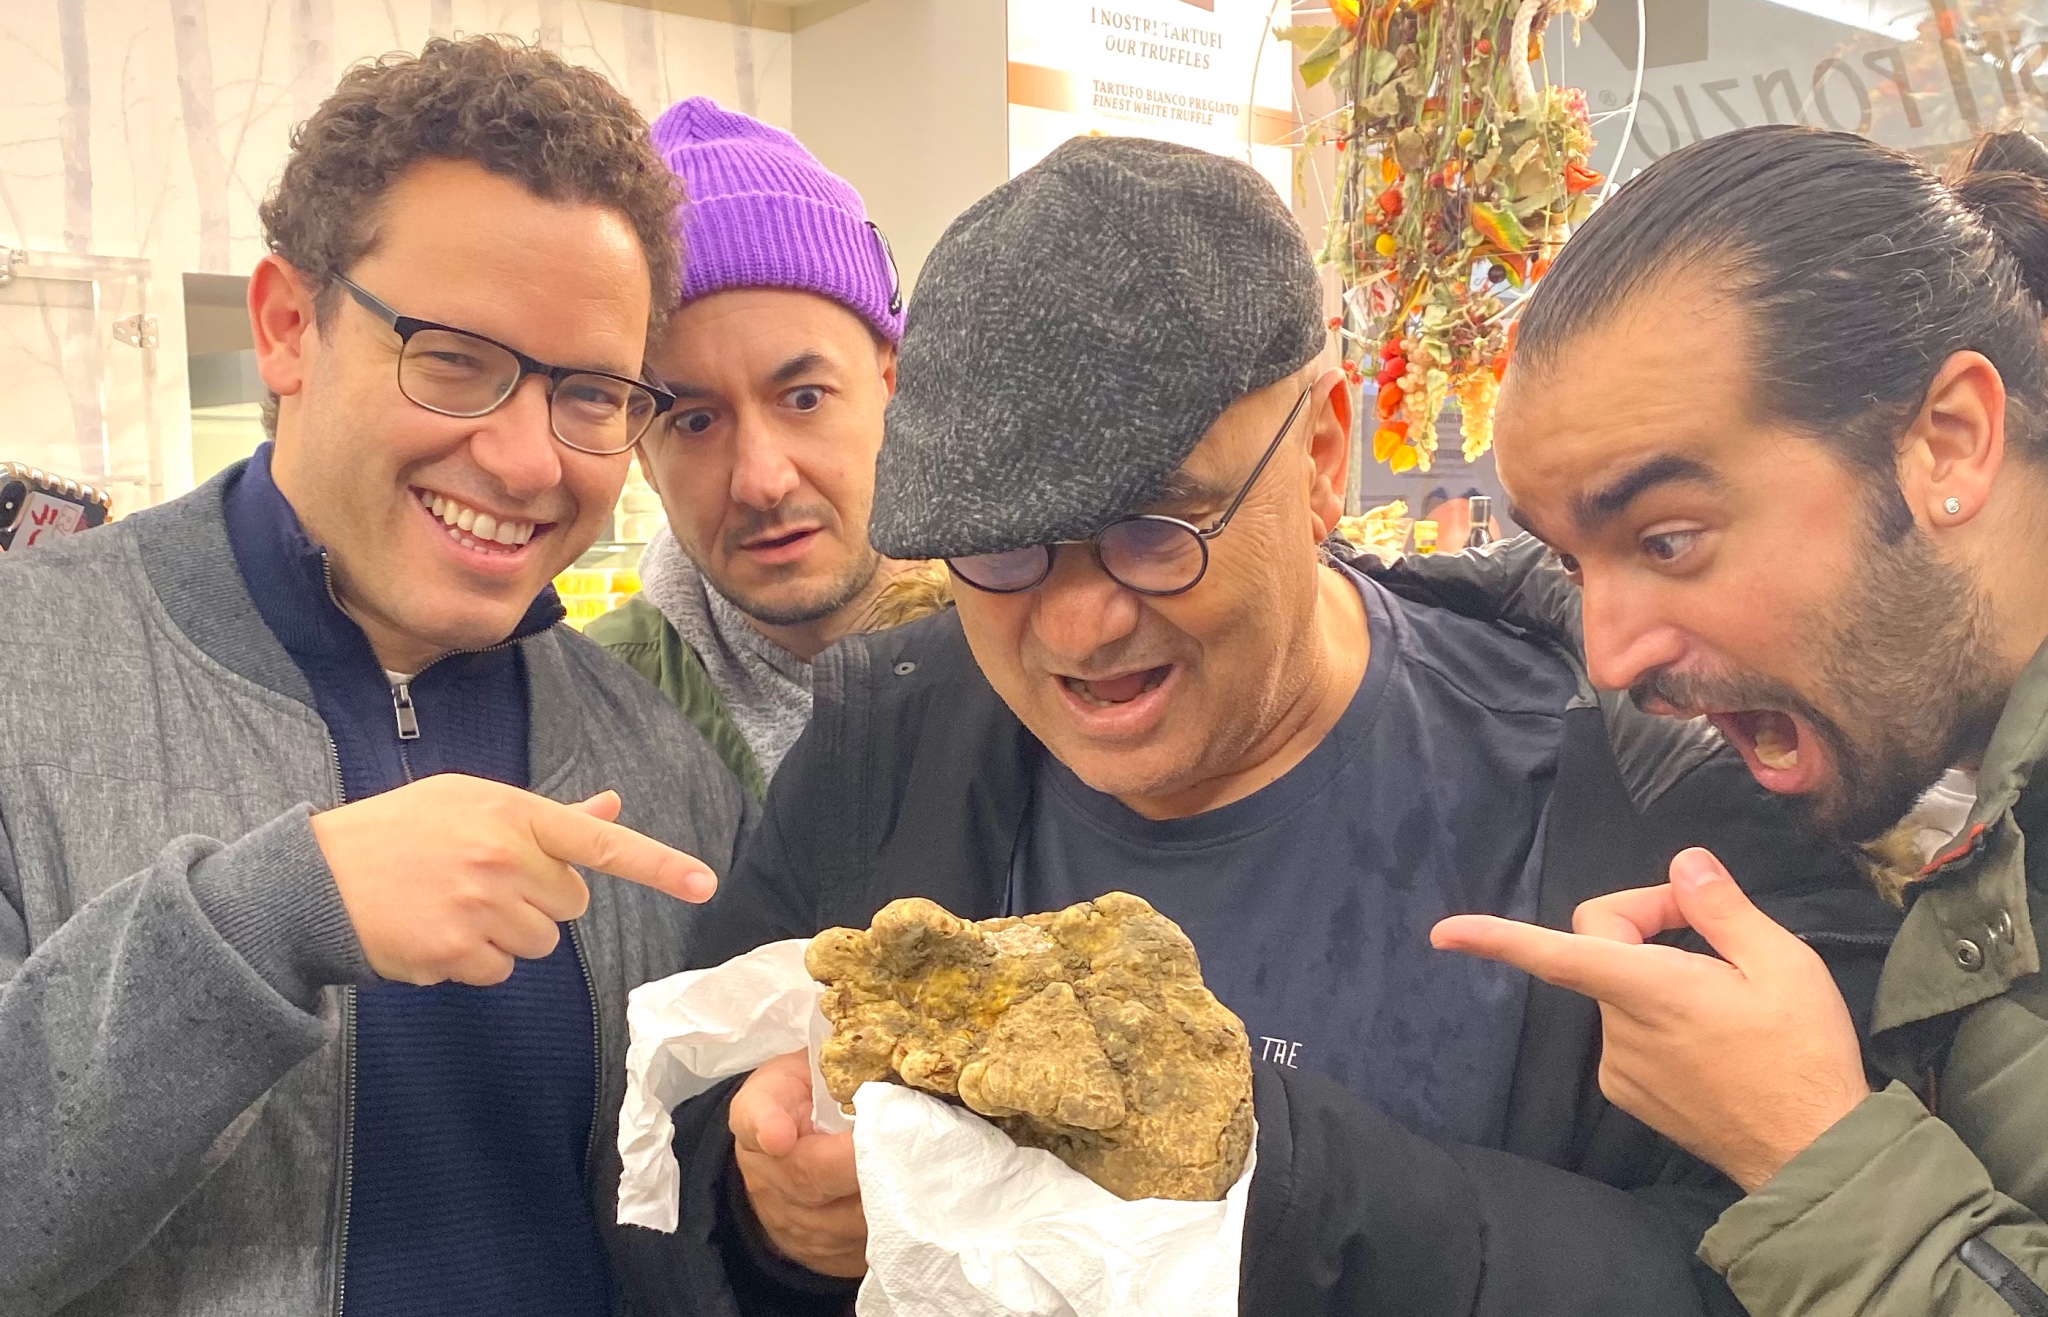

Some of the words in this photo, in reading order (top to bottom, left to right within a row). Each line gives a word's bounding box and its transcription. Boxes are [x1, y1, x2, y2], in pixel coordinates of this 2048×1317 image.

[1091, 7, 1096, 23] I
[1101, 9, 1157, 36] NOSTRI
[1162, 21, 1223, 49] TARTUFI
[1105, 34, 1136, 56] OUR
[1139, 41, 1210, 70] TRUFFLES
[1093, 79, 1143, 99] TARTUFO
[1146, 89, 1186, 107] BIANCO
[1189, 97, 1239, 116] PREGIATO
[1093, 94, 1132, 111] FINEST
[1133, 101, 1168, 118] WHITE
[1170, 107, 1214, 125] TRUFFLE
[1260, 1036, 1303, 1069] THE
